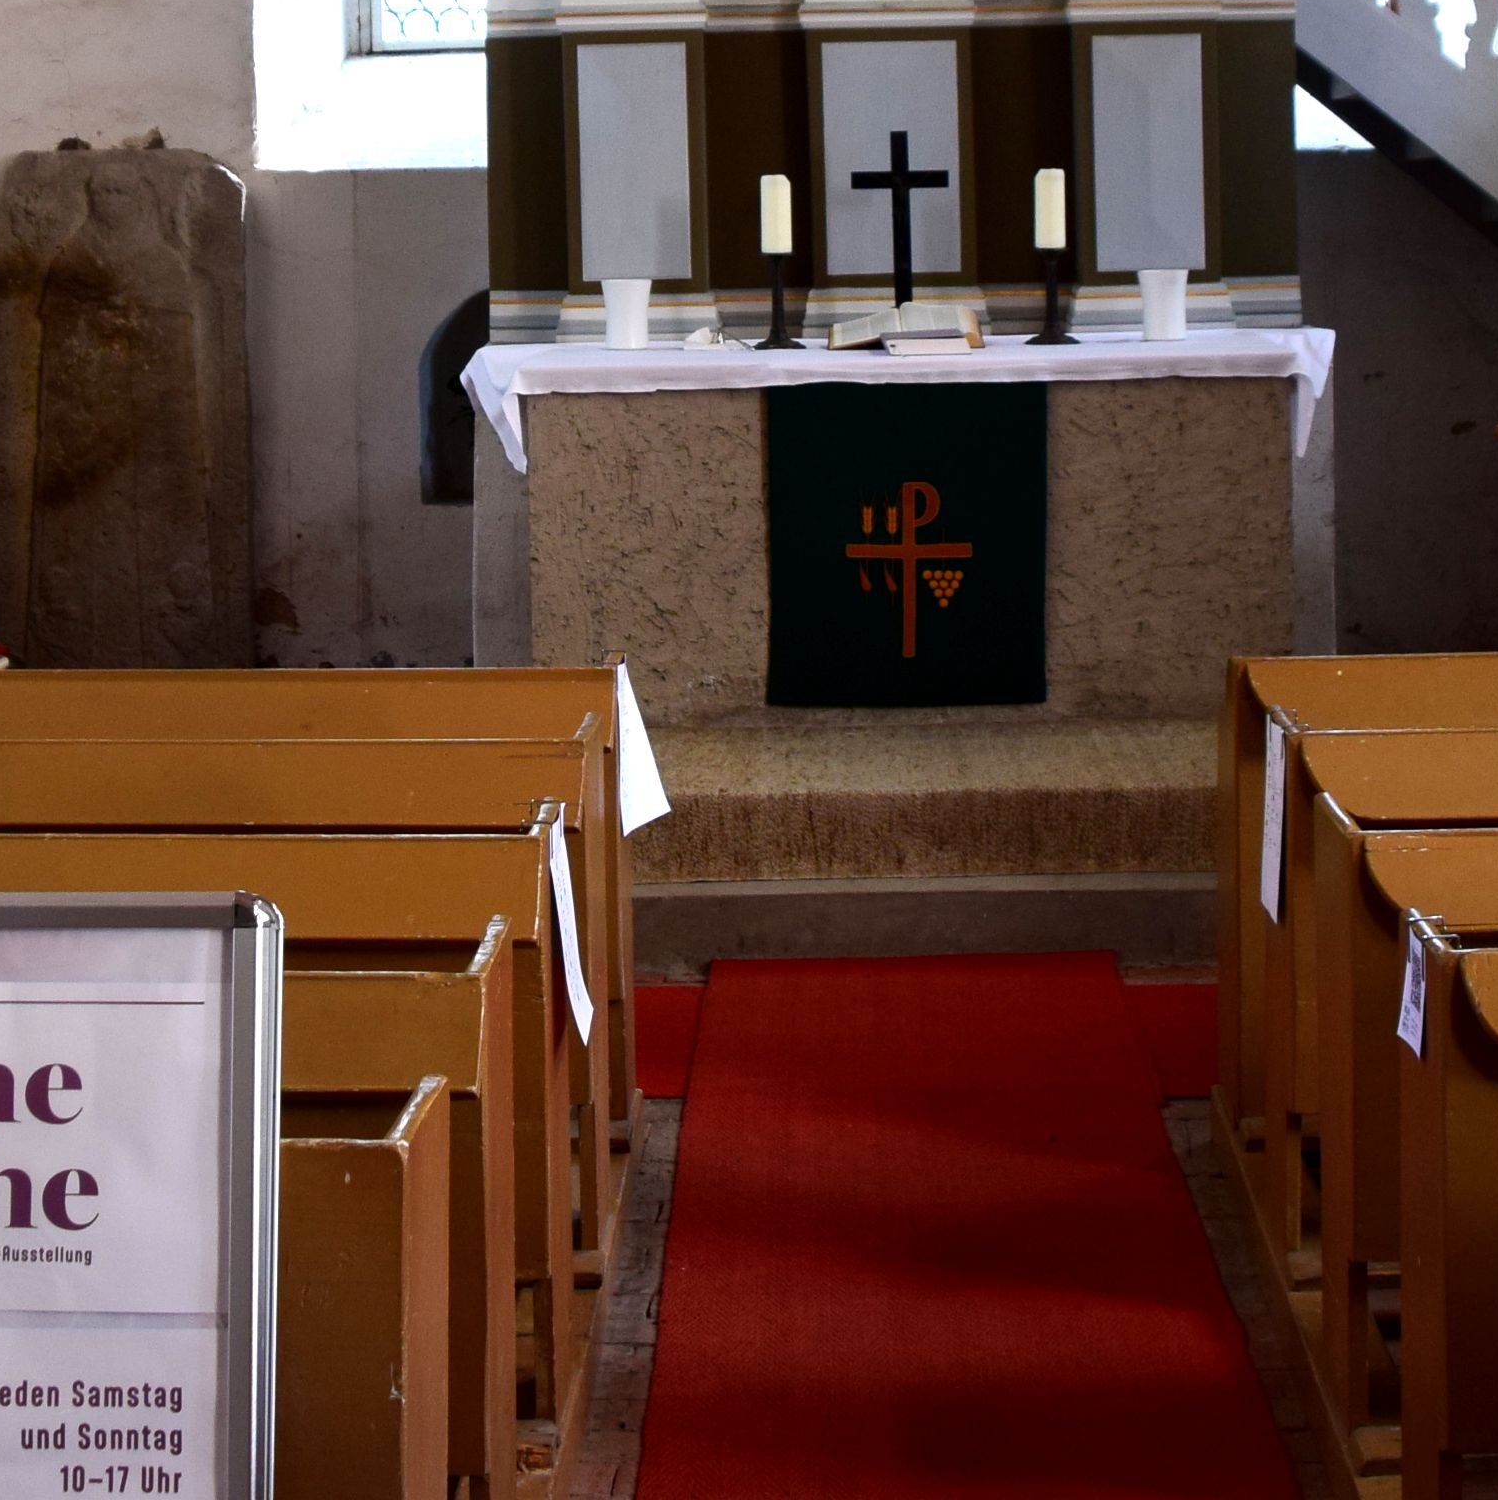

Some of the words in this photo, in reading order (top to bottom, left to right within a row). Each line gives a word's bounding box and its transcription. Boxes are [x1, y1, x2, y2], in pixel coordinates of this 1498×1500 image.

[71, 1379, 183, 1413] Samstag
[20, 1423, 67, 1450] und
[78, 1423, 183, 1455] Sonntag
[141, 1465, 182, 1494] Uhr
